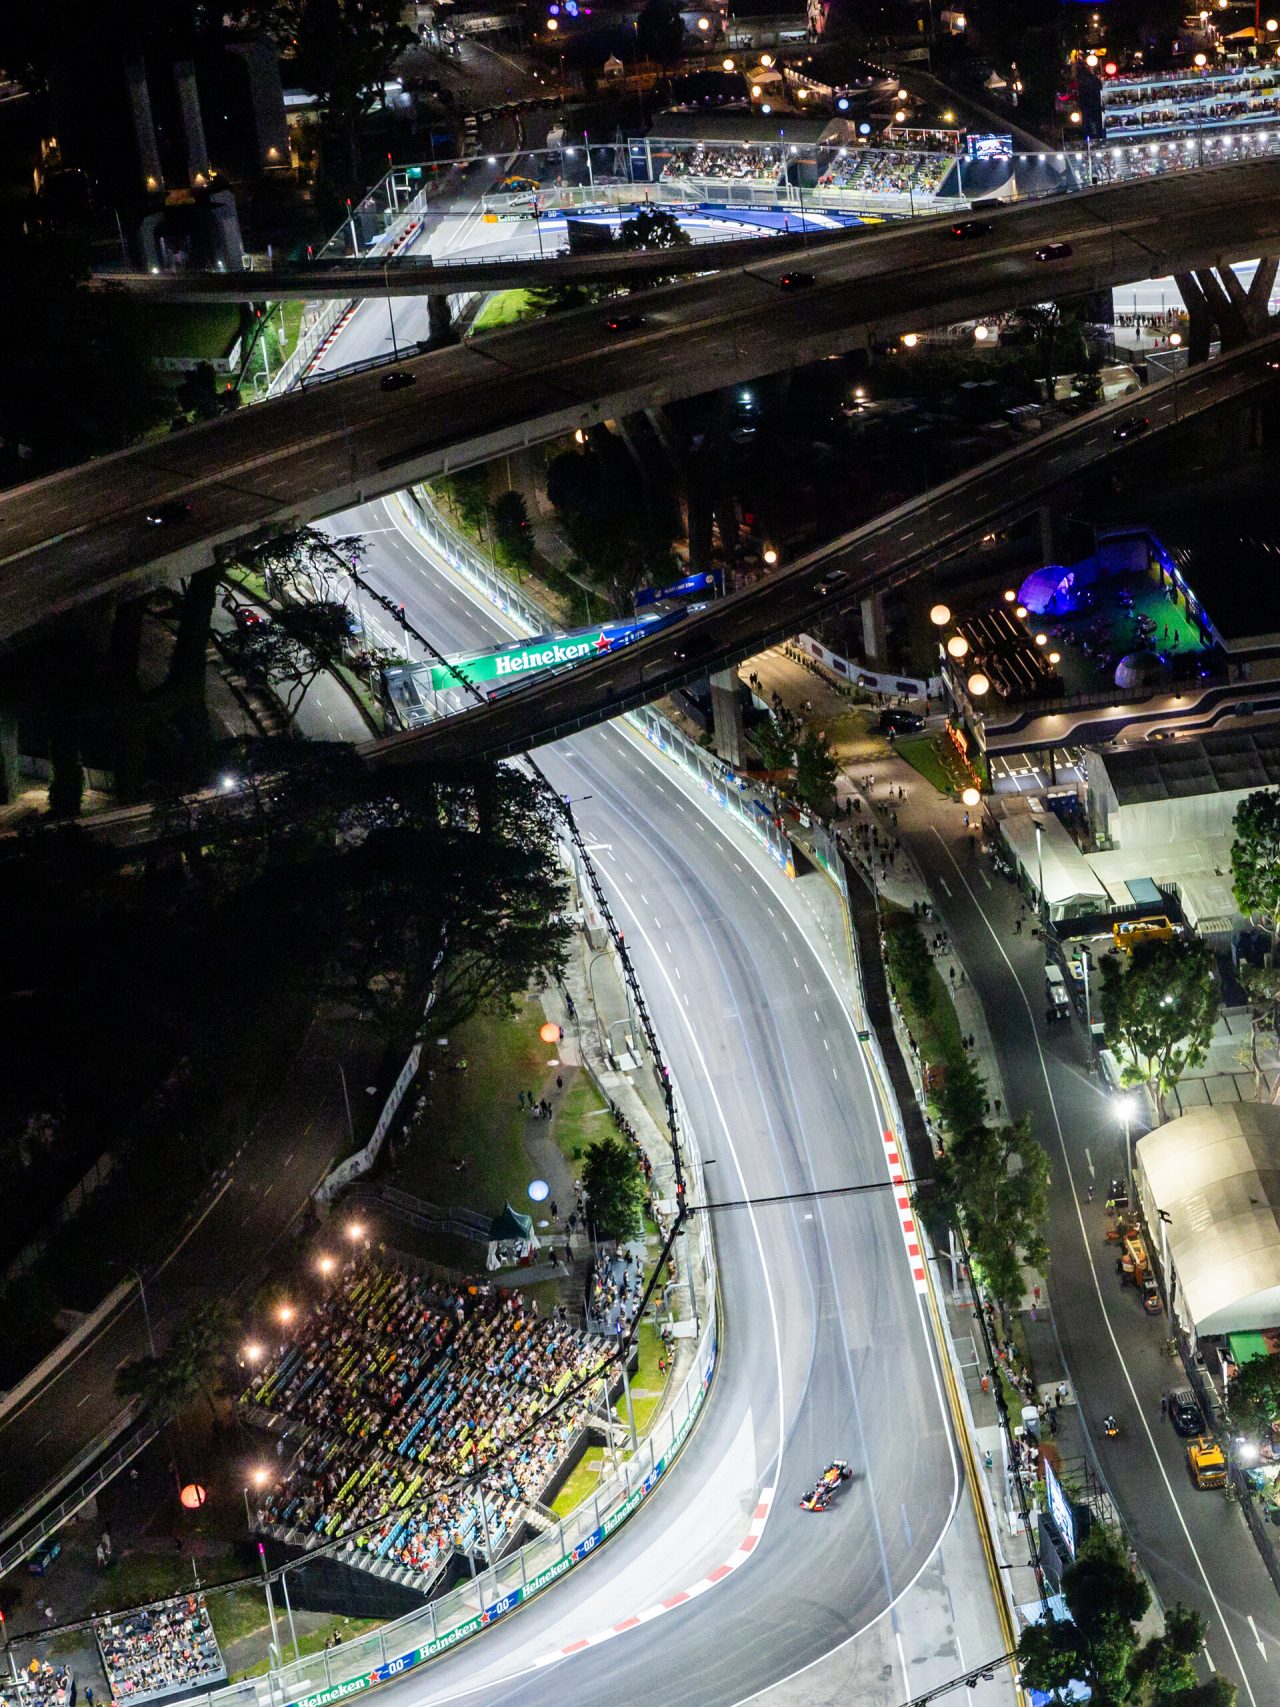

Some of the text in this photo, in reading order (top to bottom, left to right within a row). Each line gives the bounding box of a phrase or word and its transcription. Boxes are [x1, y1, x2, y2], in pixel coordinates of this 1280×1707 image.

[495, 643, 590, 676] Heineken
[603, 1494, 640, 1535] Heineken
[521, 1558, 570, 1598] Heineken
[419, 1621, 478, 1660] Heineken
[297, 1679, 366, 1707] Heineken
